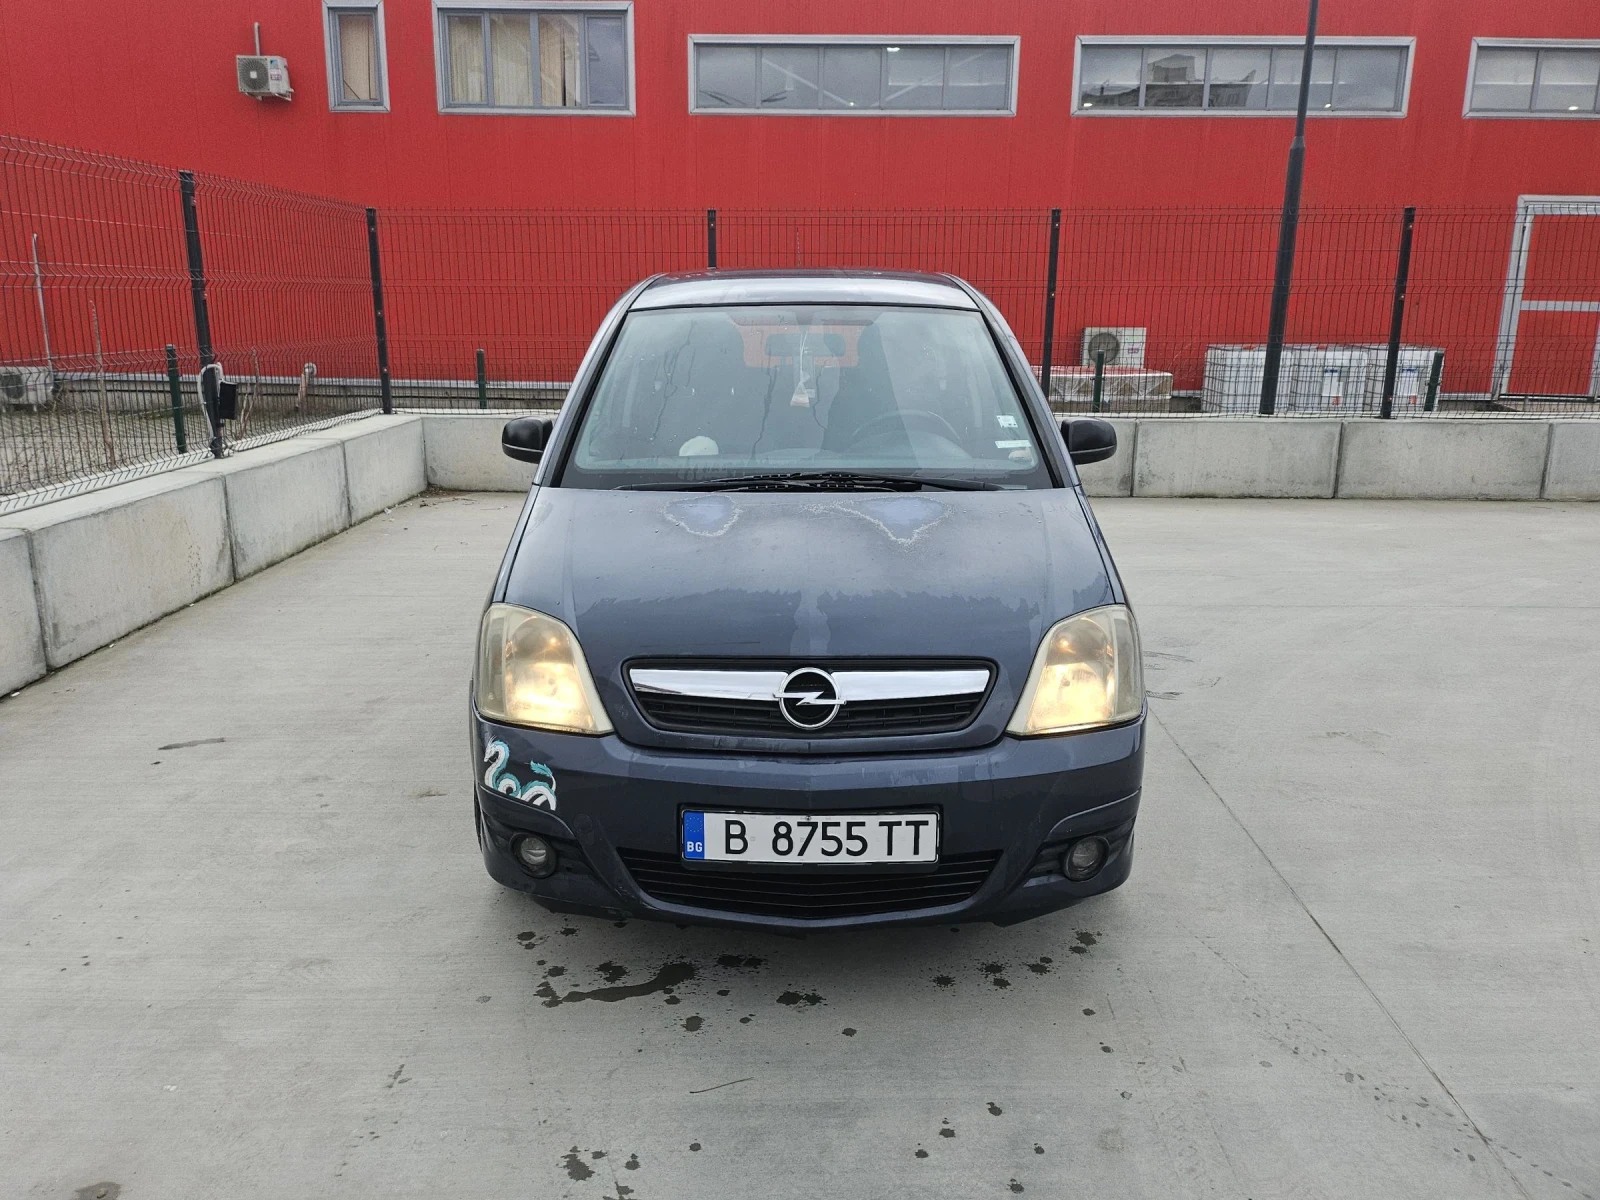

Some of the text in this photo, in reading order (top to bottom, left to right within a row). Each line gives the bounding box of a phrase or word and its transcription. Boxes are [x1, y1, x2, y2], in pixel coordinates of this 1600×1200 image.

[686, 841, 703, 852] BG
[724, 819, 929, 857] B 8755 TT
